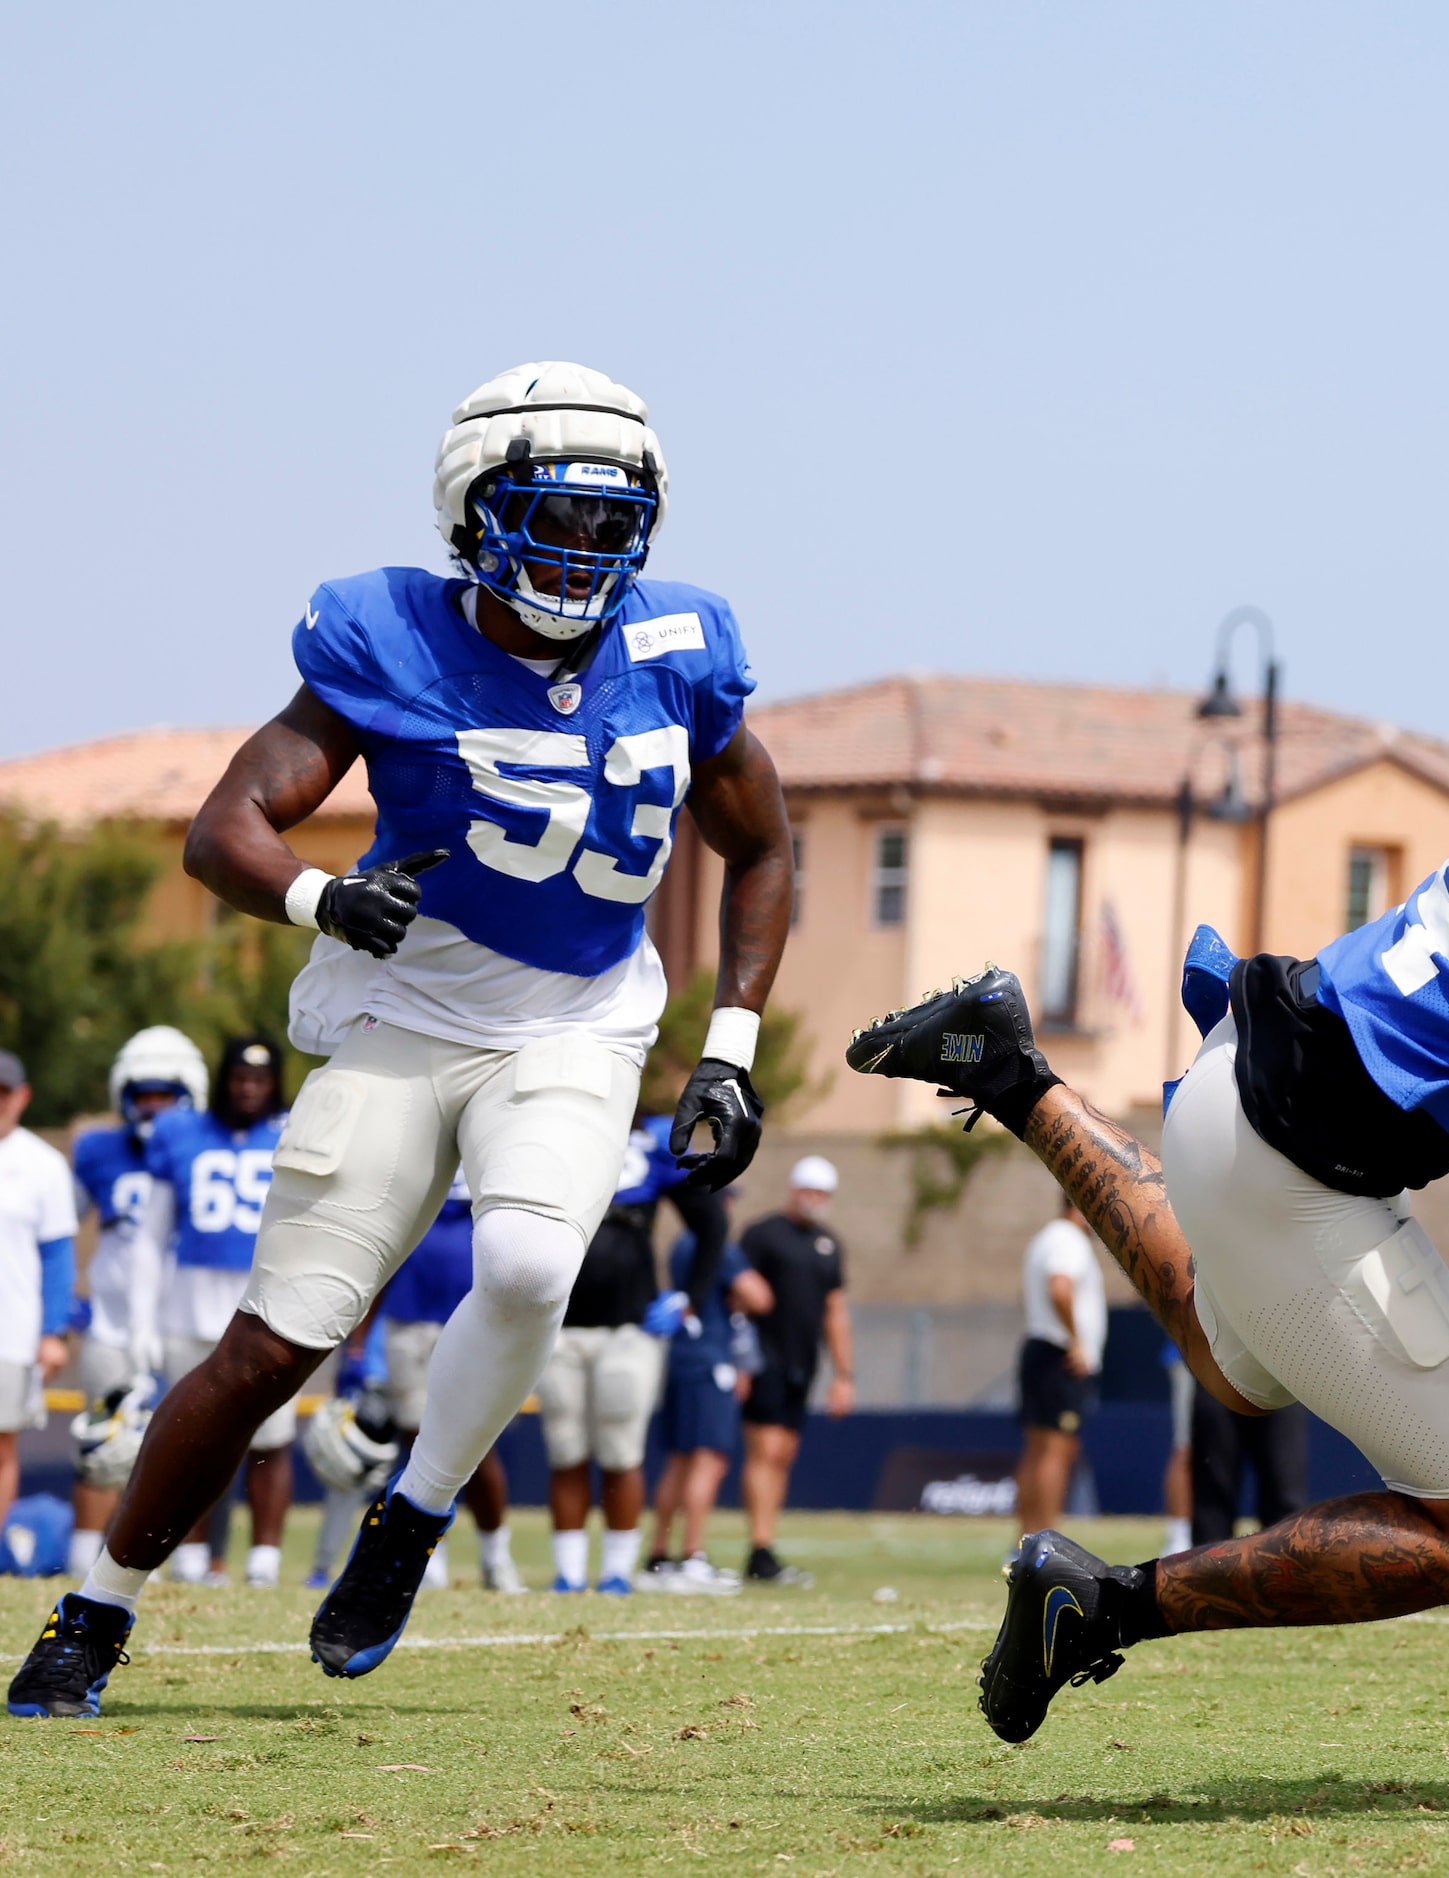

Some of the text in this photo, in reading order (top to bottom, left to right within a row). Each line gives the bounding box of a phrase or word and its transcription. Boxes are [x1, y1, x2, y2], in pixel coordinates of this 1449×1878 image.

[581, 466, 618, 478] RAMS
[659, 625, 696, 639] UNIFY
[455, 723, 692, 905] 53
[940, 1032, 985, 1063] NIKE
[1334, 1163, 1364, 1179] DRI-FIT
[190, 1148, 277, 1234] 65
